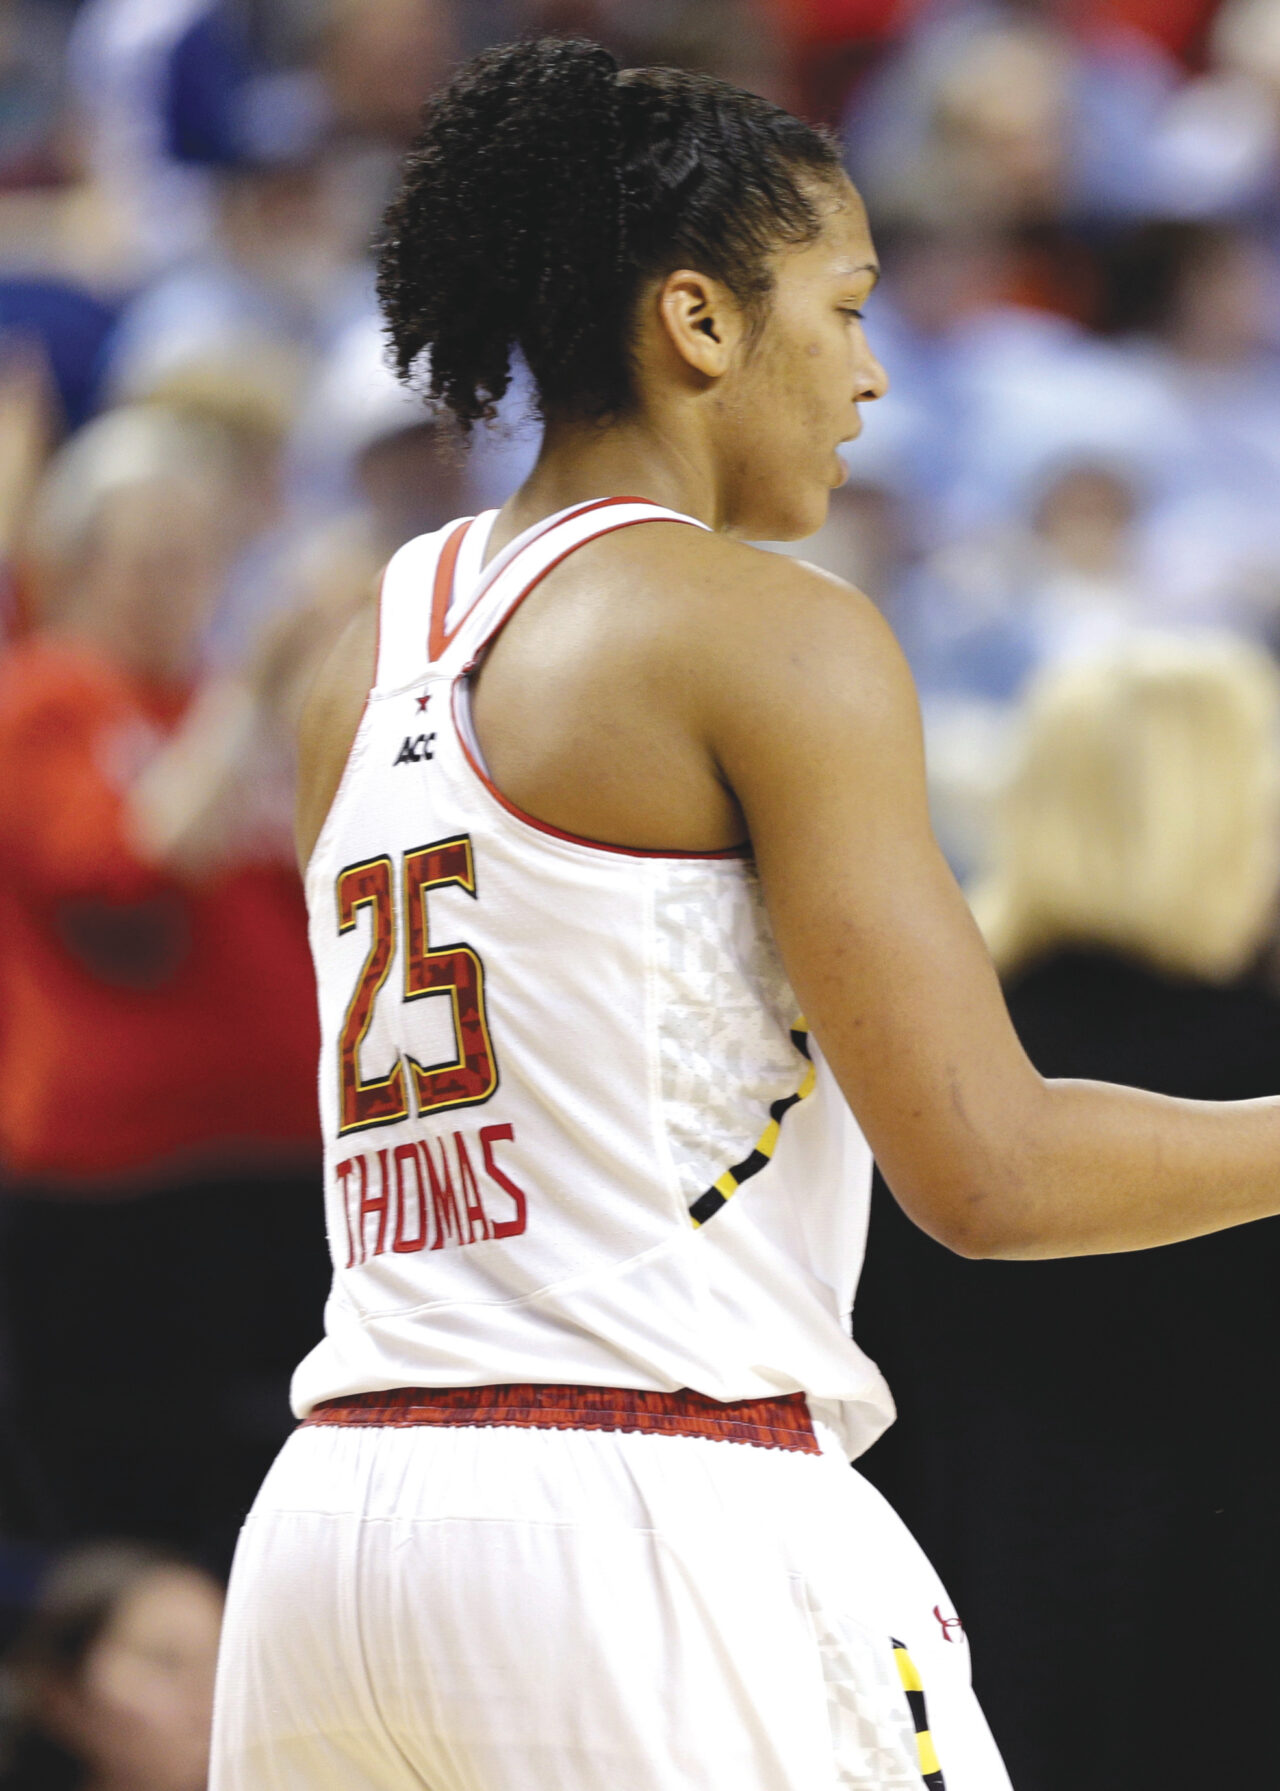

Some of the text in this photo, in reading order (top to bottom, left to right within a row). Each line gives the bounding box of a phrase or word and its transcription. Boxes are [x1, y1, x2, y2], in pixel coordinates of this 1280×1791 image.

[393, 732, 437, 767] ACC
[337, 833, 501, 1139] 25
[336, 1123, 528, 1270] THOMAS
